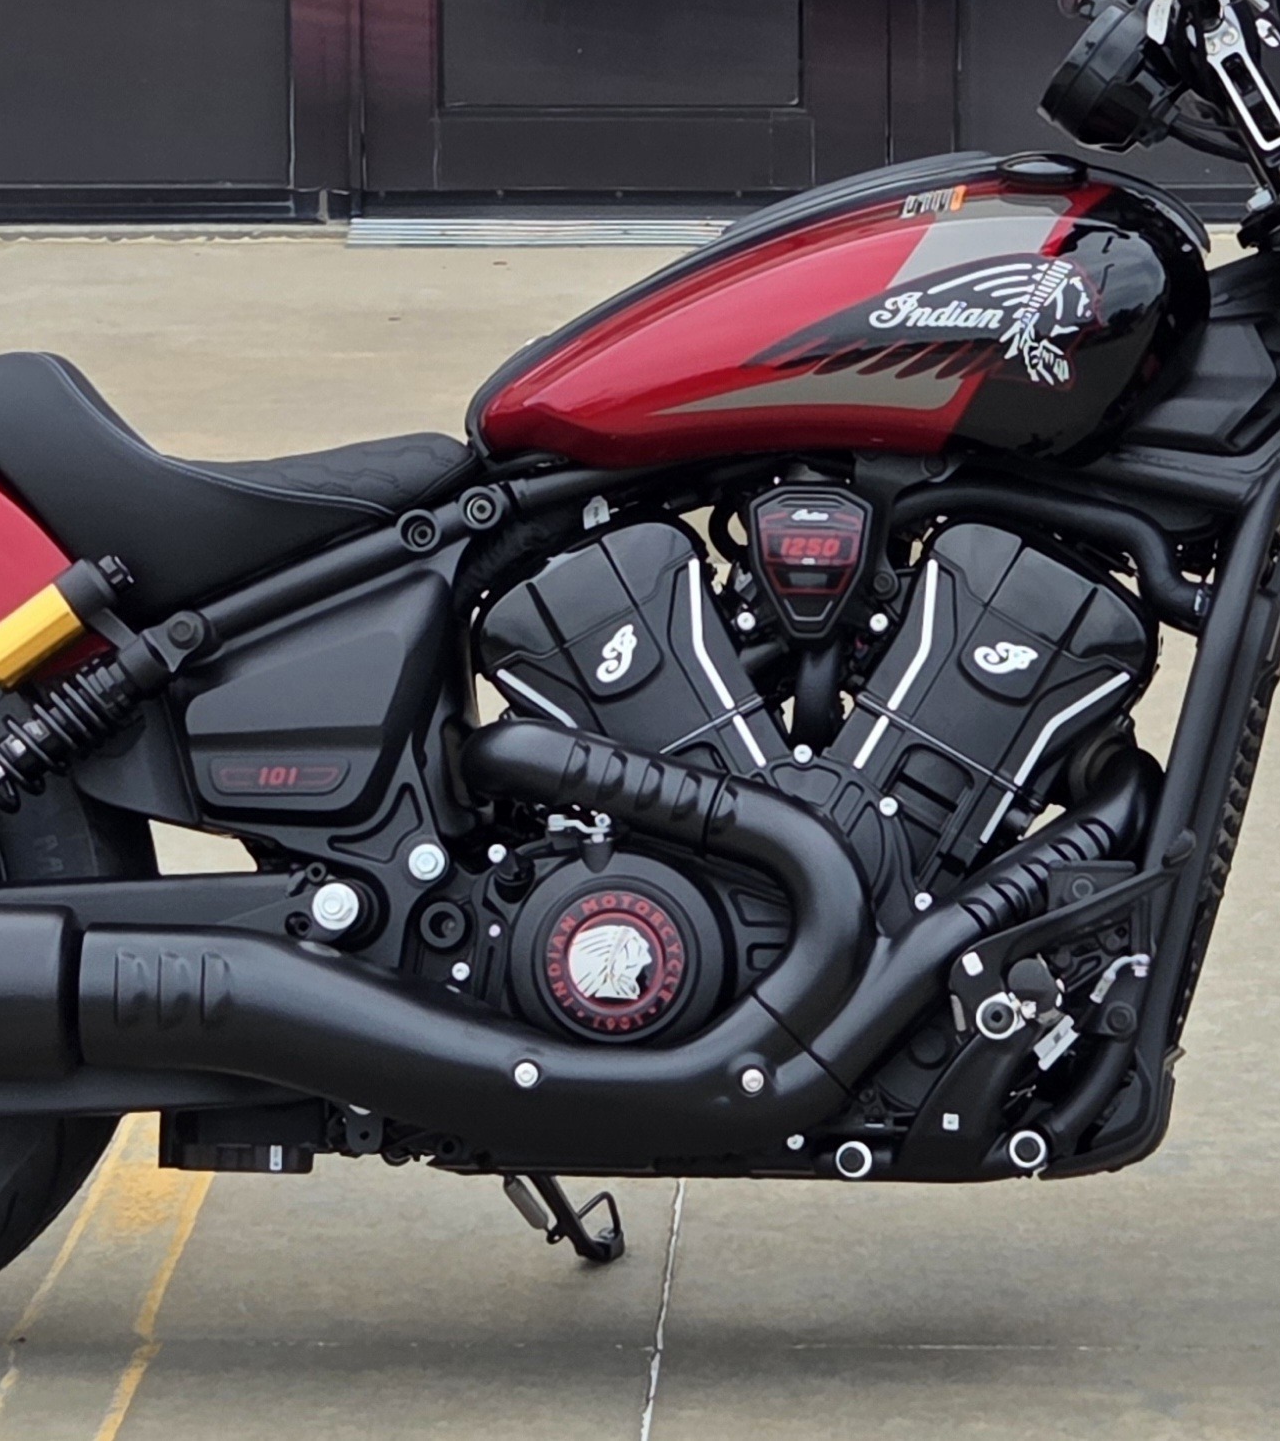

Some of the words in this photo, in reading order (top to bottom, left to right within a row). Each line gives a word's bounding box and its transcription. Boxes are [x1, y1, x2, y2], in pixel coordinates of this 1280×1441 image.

[869, 291, 1004, 330] Indian
[781, 536, 840, 557] 1250
[258, 766, 300, 786] 101
[547, 915, 576, 1007] INDIAN
[581, 892, 682, 1002] MOTORCYCLE
